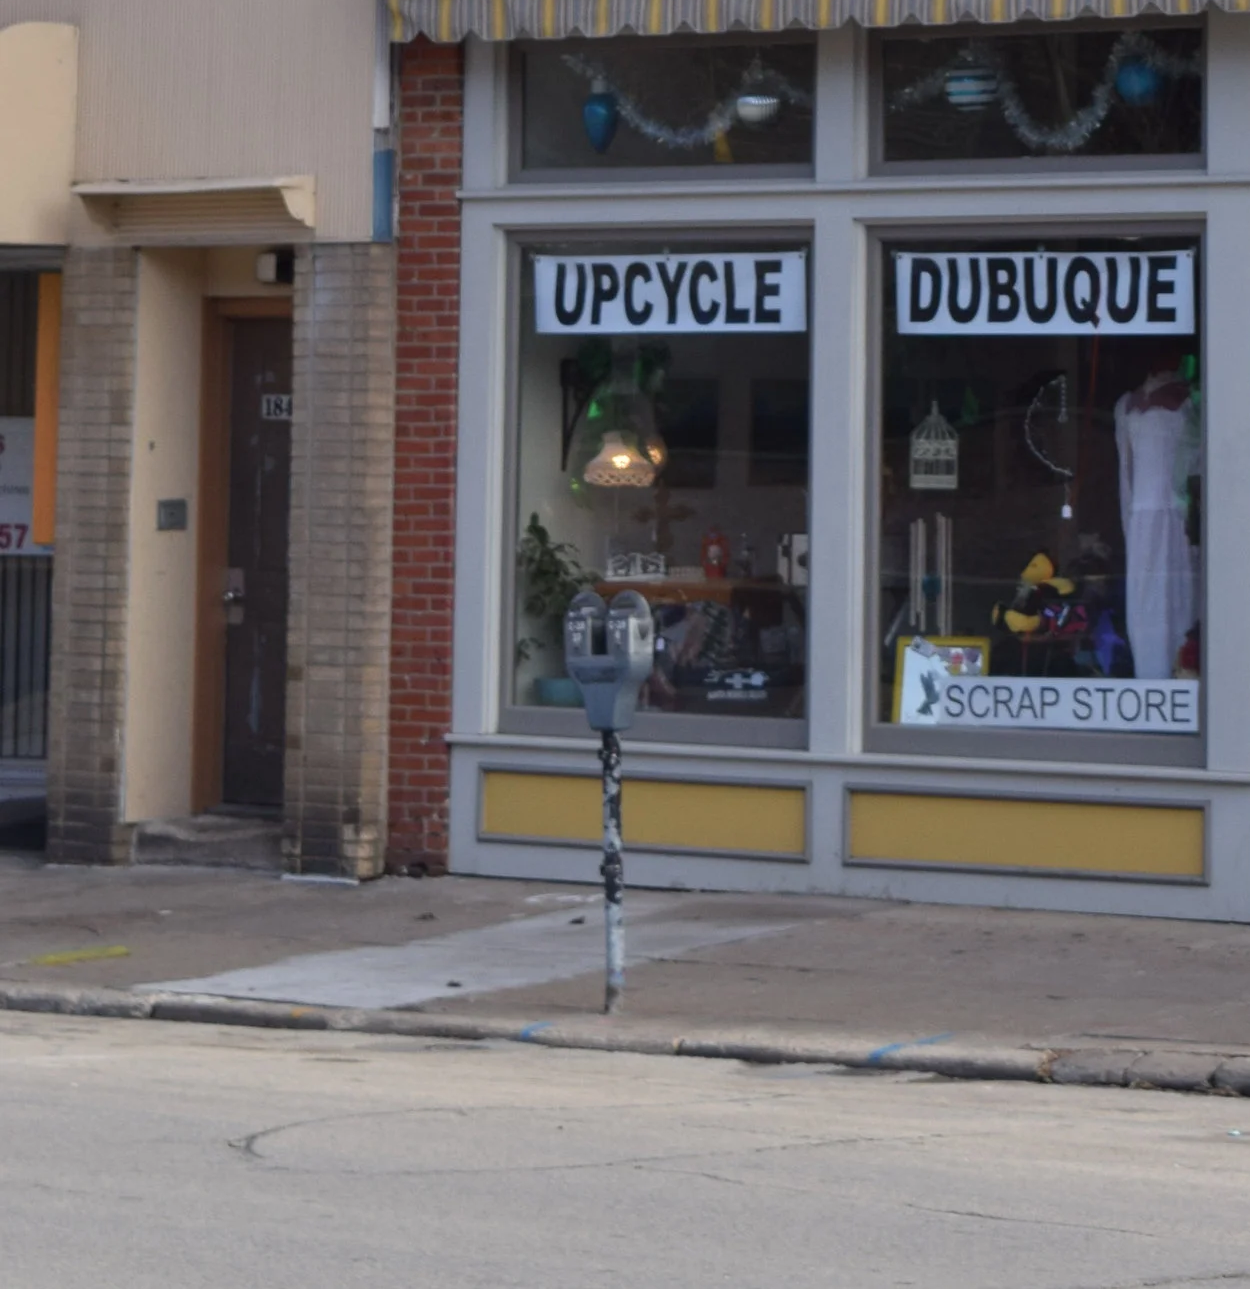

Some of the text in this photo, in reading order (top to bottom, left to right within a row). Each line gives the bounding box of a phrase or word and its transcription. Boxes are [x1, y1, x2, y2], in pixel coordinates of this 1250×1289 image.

[554, 255, 1177, 328] UPCYCLE DUBUQUE
[944, 684, 1191, 723] SCRAP STORE
